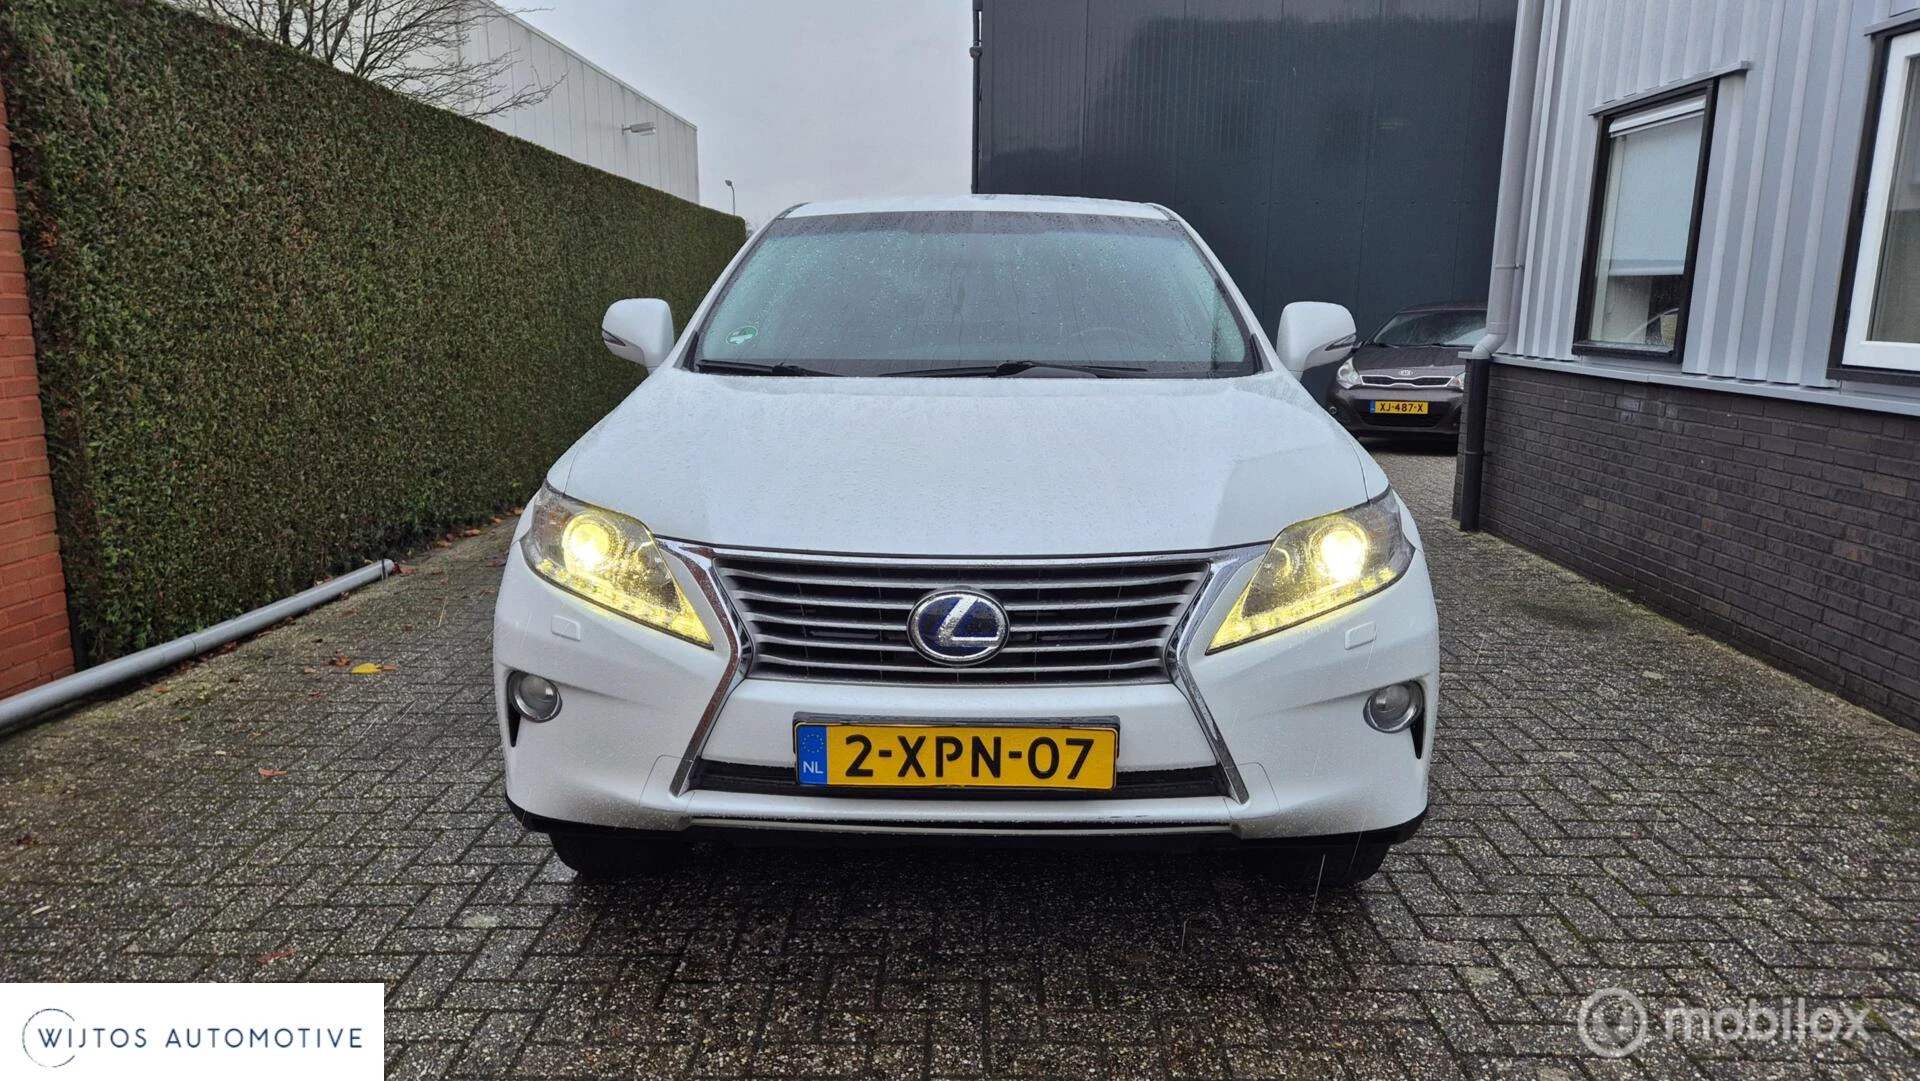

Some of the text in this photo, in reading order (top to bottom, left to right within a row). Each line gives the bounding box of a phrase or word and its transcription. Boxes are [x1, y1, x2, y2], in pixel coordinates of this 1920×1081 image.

[1380, 402, 1424, 413] XJ-487-X
[845, 734, 1094, 780] 2-XPN-07
[803, 761, 823, 774] NL
